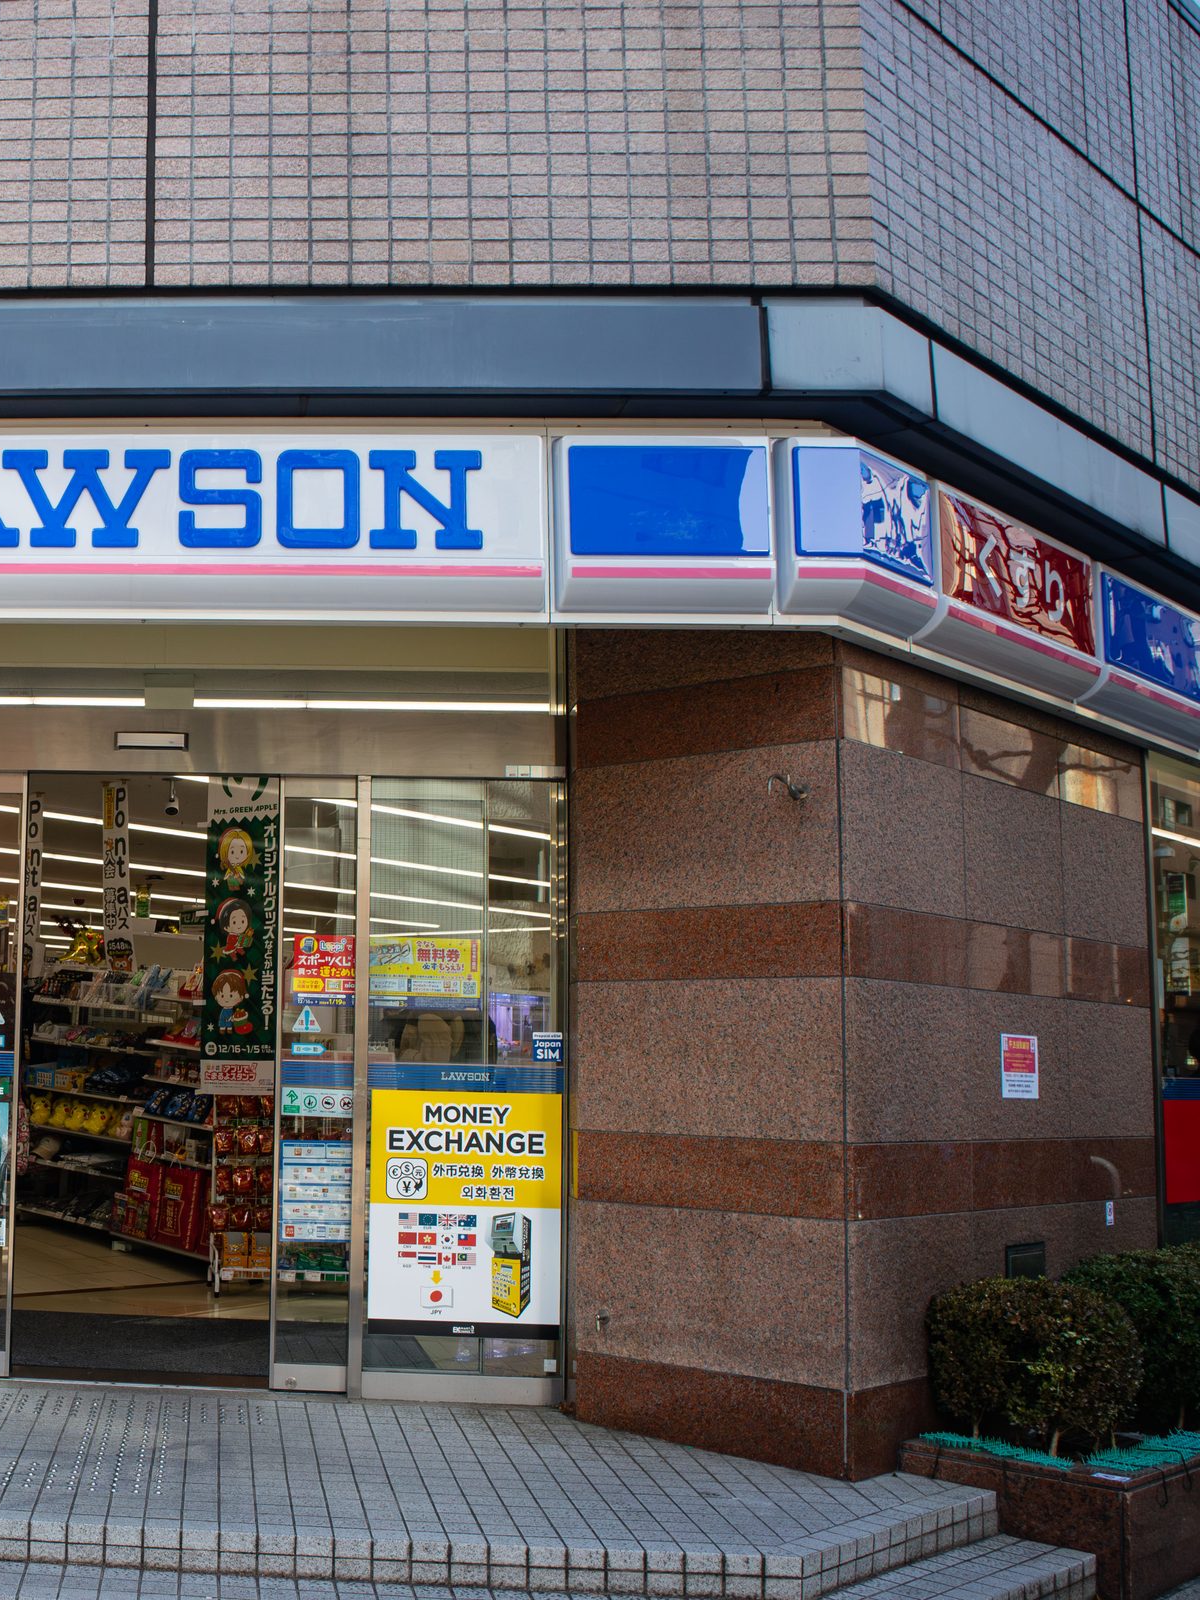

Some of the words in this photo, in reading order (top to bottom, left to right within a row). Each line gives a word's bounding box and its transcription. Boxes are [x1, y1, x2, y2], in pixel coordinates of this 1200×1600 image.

[978, 533, 1065, 623] くすり
[229, 806, 253, 814] GREEN
[254, 803, 278, 812] APPLE
[417, 948, 460, 962] 無料券
[534, 1040, 561, 1048] Japan
[536, 1048, 560, 1059] SIM
[440, 1071, 490, 1083] LAWSON
[424, 1105, 510, 1125] MONEY
[388, 1130, 545, 1156] EXCHANGE
[432, 1164, 484, 1178] 外币兑换
[492, 1165, 545, 1180] 外幣兌換
[462, 1186, 515, 1200] 외화환전
